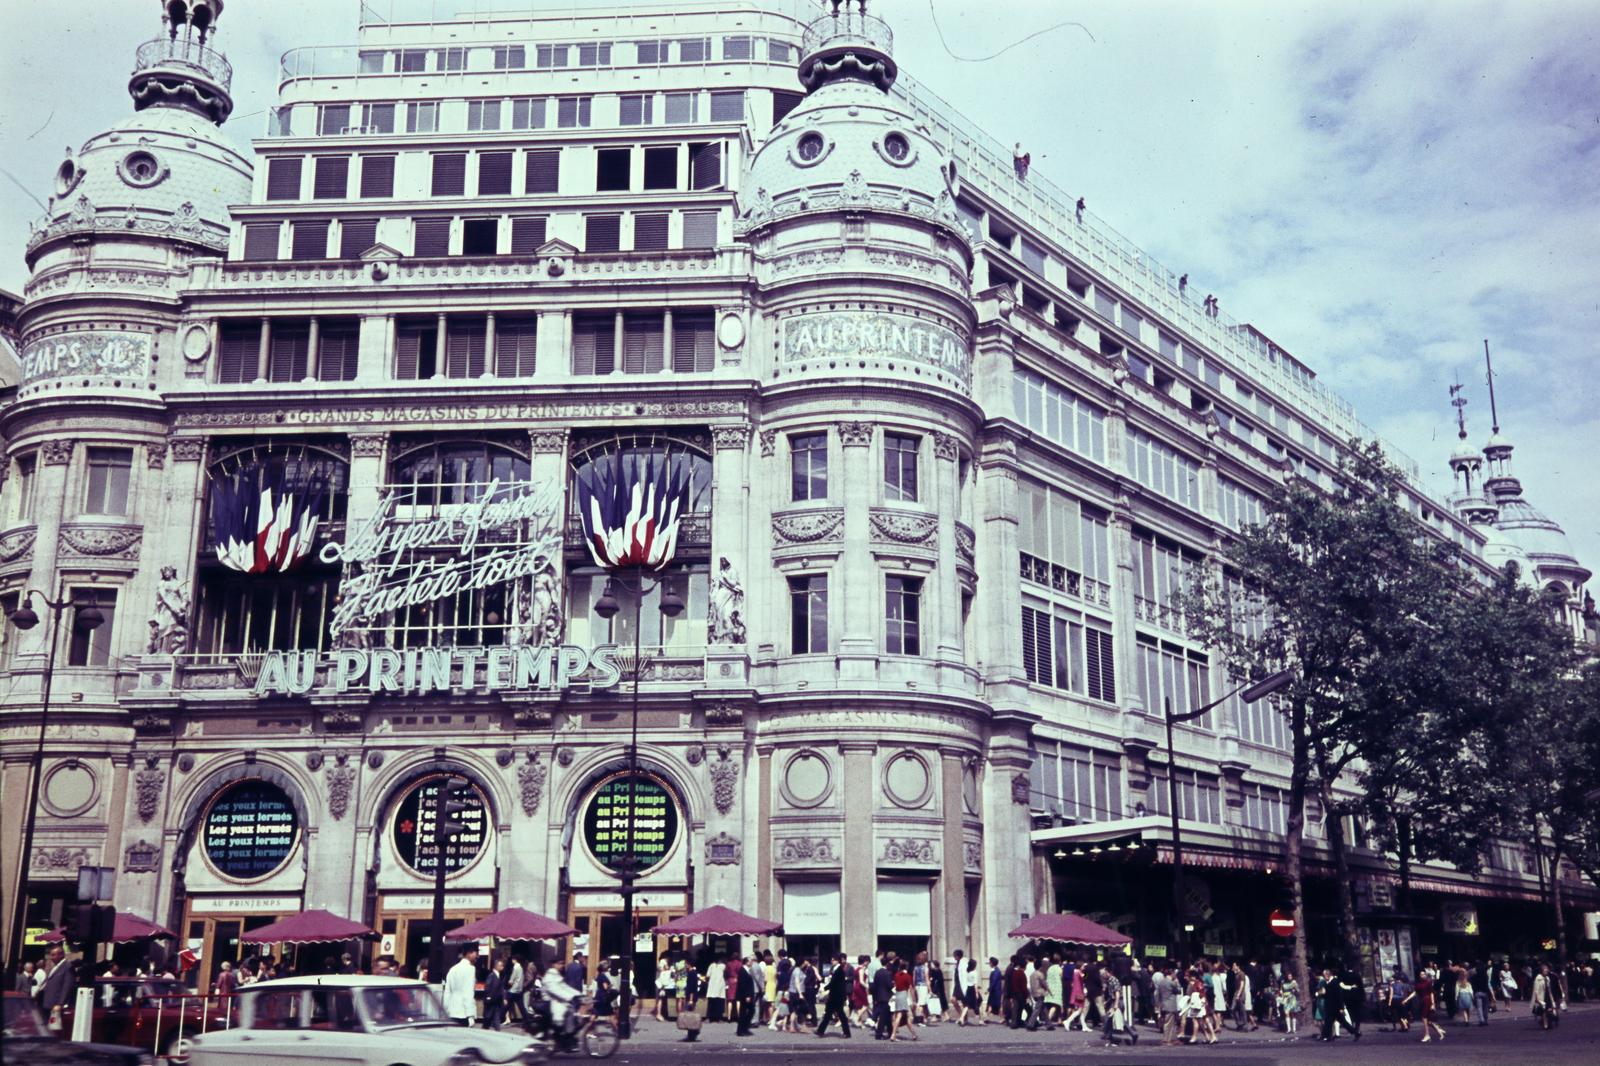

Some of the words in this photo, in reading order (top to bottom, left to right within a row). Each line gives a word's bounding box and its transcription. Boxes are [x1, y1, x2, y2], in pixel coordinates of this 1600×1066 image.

[842, 322, 968, 371] PRINTEMP
[298, 408, 374, 424] GRANDS
[382, 406, 478, 422] MAGASINS
[485, 405, 511, 420] DU
[255, 648, 316, 695] AU
[336, 643, 623, 692] PRINTEMPS
[597, 795, 611, 805] au
[596, 807, 611, 817] au
[596, 819, 610, 829] au
[595, 831, 610, 841] au
[595, 843, 609, 852] au
